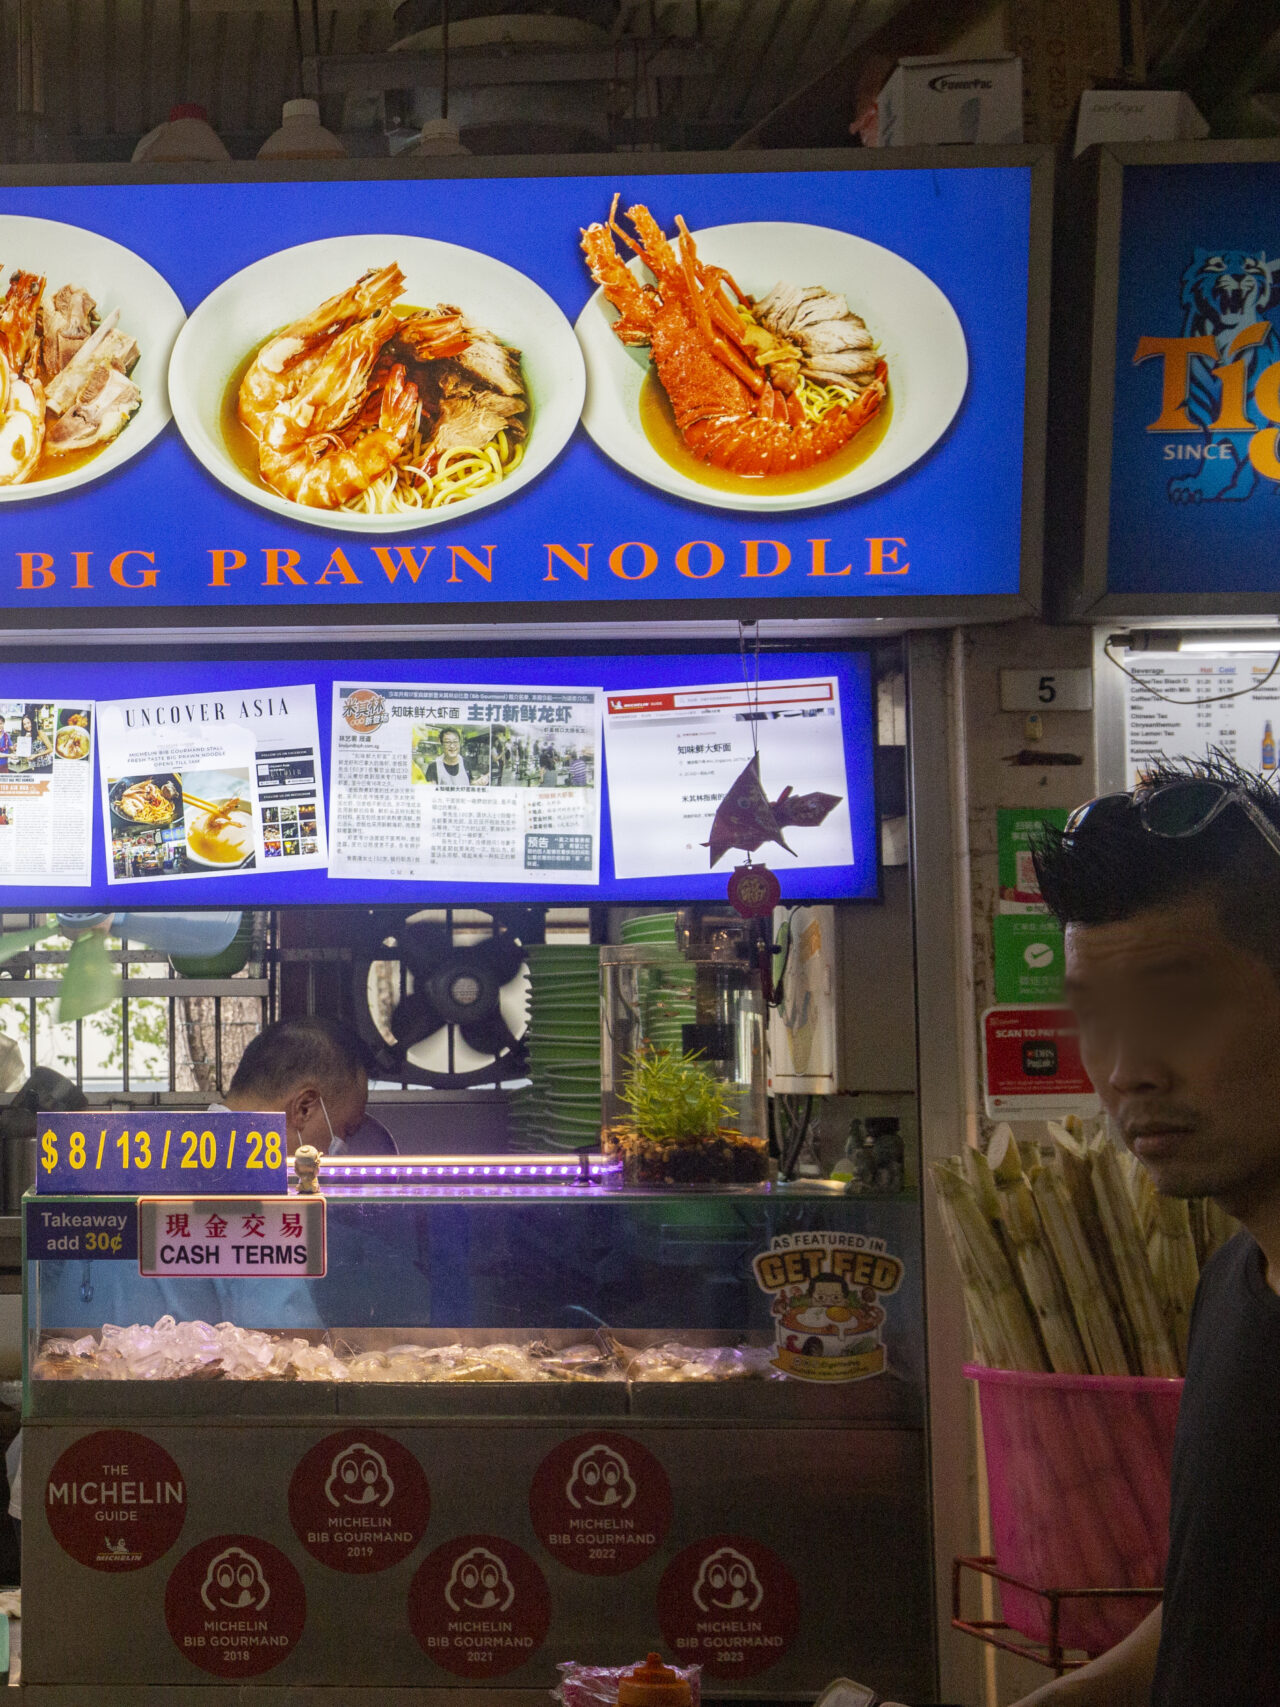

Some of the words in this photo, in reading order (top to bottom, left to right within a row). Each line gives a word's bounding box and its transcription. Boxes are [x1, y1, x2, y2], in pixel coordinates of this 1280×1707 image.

[940, 79, 993, 91] PowerPac
[1164, 443, 1233, 460] SINCE
[15, 550, 161, 590] BIG
[207, 543, 497, 587] PRAWN
[543, 538, 910, 581] NOODLE
[1038, 677, 1056, 703] 5
[125, 702, 225, 728] UNCOVER
[239, 697, 289, 719] ASIA
[342, 695, 386, 719] 米其林
[391, 705, 461, 719] 知味鲜大虾面
[467, 703, 573, 724] 主打新鲜龙虾
[171, 747, 205, 755] GOURMAND
[677, 742, 732, 754] 知味鲜大虾面
[527, 836, 549, 848] 预告
[995, 1029, 1022, 1038] SCAN
[1024, 1028, 1037, 1037] TO
[1038, 1028, 1054, 1036] PAY
[41, 1129, 58, 1174] $
[69, 1131, 86, 1169] 8
[96, 1130, 108, 1169] /
[116, 1130, 153, 1169] 13
[161, 1130, 172, 1169] /
[180, 1130, 217, 1169] 20
[226, 1130, 237, 1169] /
[245, 1130, 282, 1169] 28
[41, 1212, 127, 1231] Takeaway
[165, 1213, 304, 1239] 現金交易
[46, 1235, 79, 1251] add
[85, 1232, 122, 1253] 30¢
[773, 1237, 790, 1251] AS
[794, 1235, 865, 1248] FEATURED
[869, 1240, 884, 1252] IN
[160, 1245, 220, 1265] CASH
[231, 1245, 308, 1265] TERMS
[758, 1250, 825, 1289] GET
[833, 1250, 900, 1291] FED
[102, 1465, 129, 1475] THE
[48, 1482, 183, 1504] MICHELIN
[94, 1511, 138, 1522] GUIDE
[328, 1516, 392, 1528] MICHELIN
[569, 1518, 634, 1530] MICHELIN
[307, 1531, 329, 1543] BIB
[333, 1531, 413, 1543] GOURMAND
[549, 1533, 571, 1545] BIB
[575, 1533, 655, 1545] GOURMAND
[95, 1553, 142, 1561] MICHELIN
[346, 1547, 374, 1558] 2019
[588, 1547, 616, 1559] 2022
[204, 1620, 268, 1632] MICHELIN
[447, 1621, 512, 1633] MICHELIN
[696, 1622, 762, 1633] MICHELIN
[183, 1635, 206, 1647] BIB
[210, 1635, 289, 1647] GOURMAND
[427, 1636, 450, 1648] BIB
[453, 1636, 534, 1648] GOURMAND
[676, 1636, 699, 1648] BIB
[703, 1636, 783, 1648] GOURMAND
[223, 1650, 250, 1661] 2018
[467, 1651, 493, 1662] 2021
[716, 1651, 744, 1662] 2023
